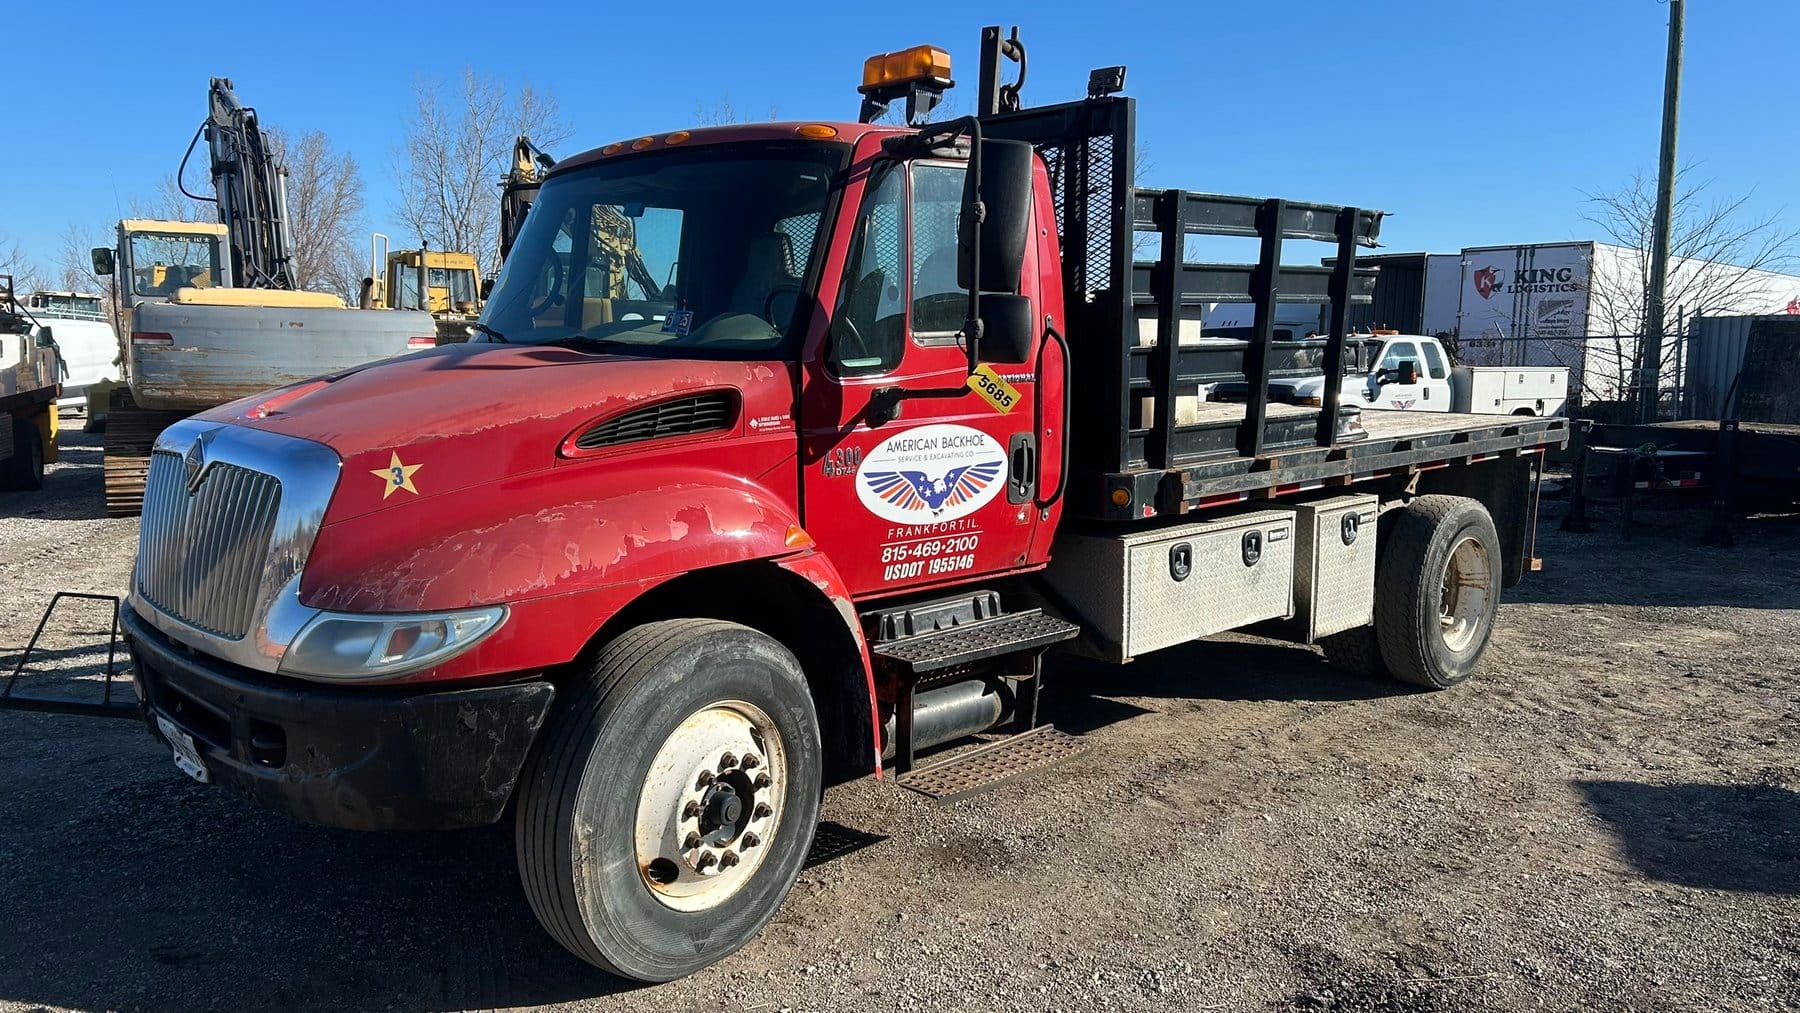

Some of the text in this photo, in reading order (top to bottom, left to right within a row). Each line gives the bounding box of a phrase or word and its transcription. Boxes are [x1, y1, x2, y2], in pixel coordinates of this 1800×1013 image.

[1513, 268, 1572, 283] KING
[1508, 284, 1578, 294] LOGISTICS
[978, 375, 1013, 407] 5685
[887, 434, 985, 453] AMERICAN BACKHOE
[823, 446, 862, 476] 4300
[898, 454, 922, 463] SERVICE
[930, 452, 964, 461] EXCAVATING
[391, 467, 404, 485] 3
[884, 554, 975, 580] USDOT 1955146
